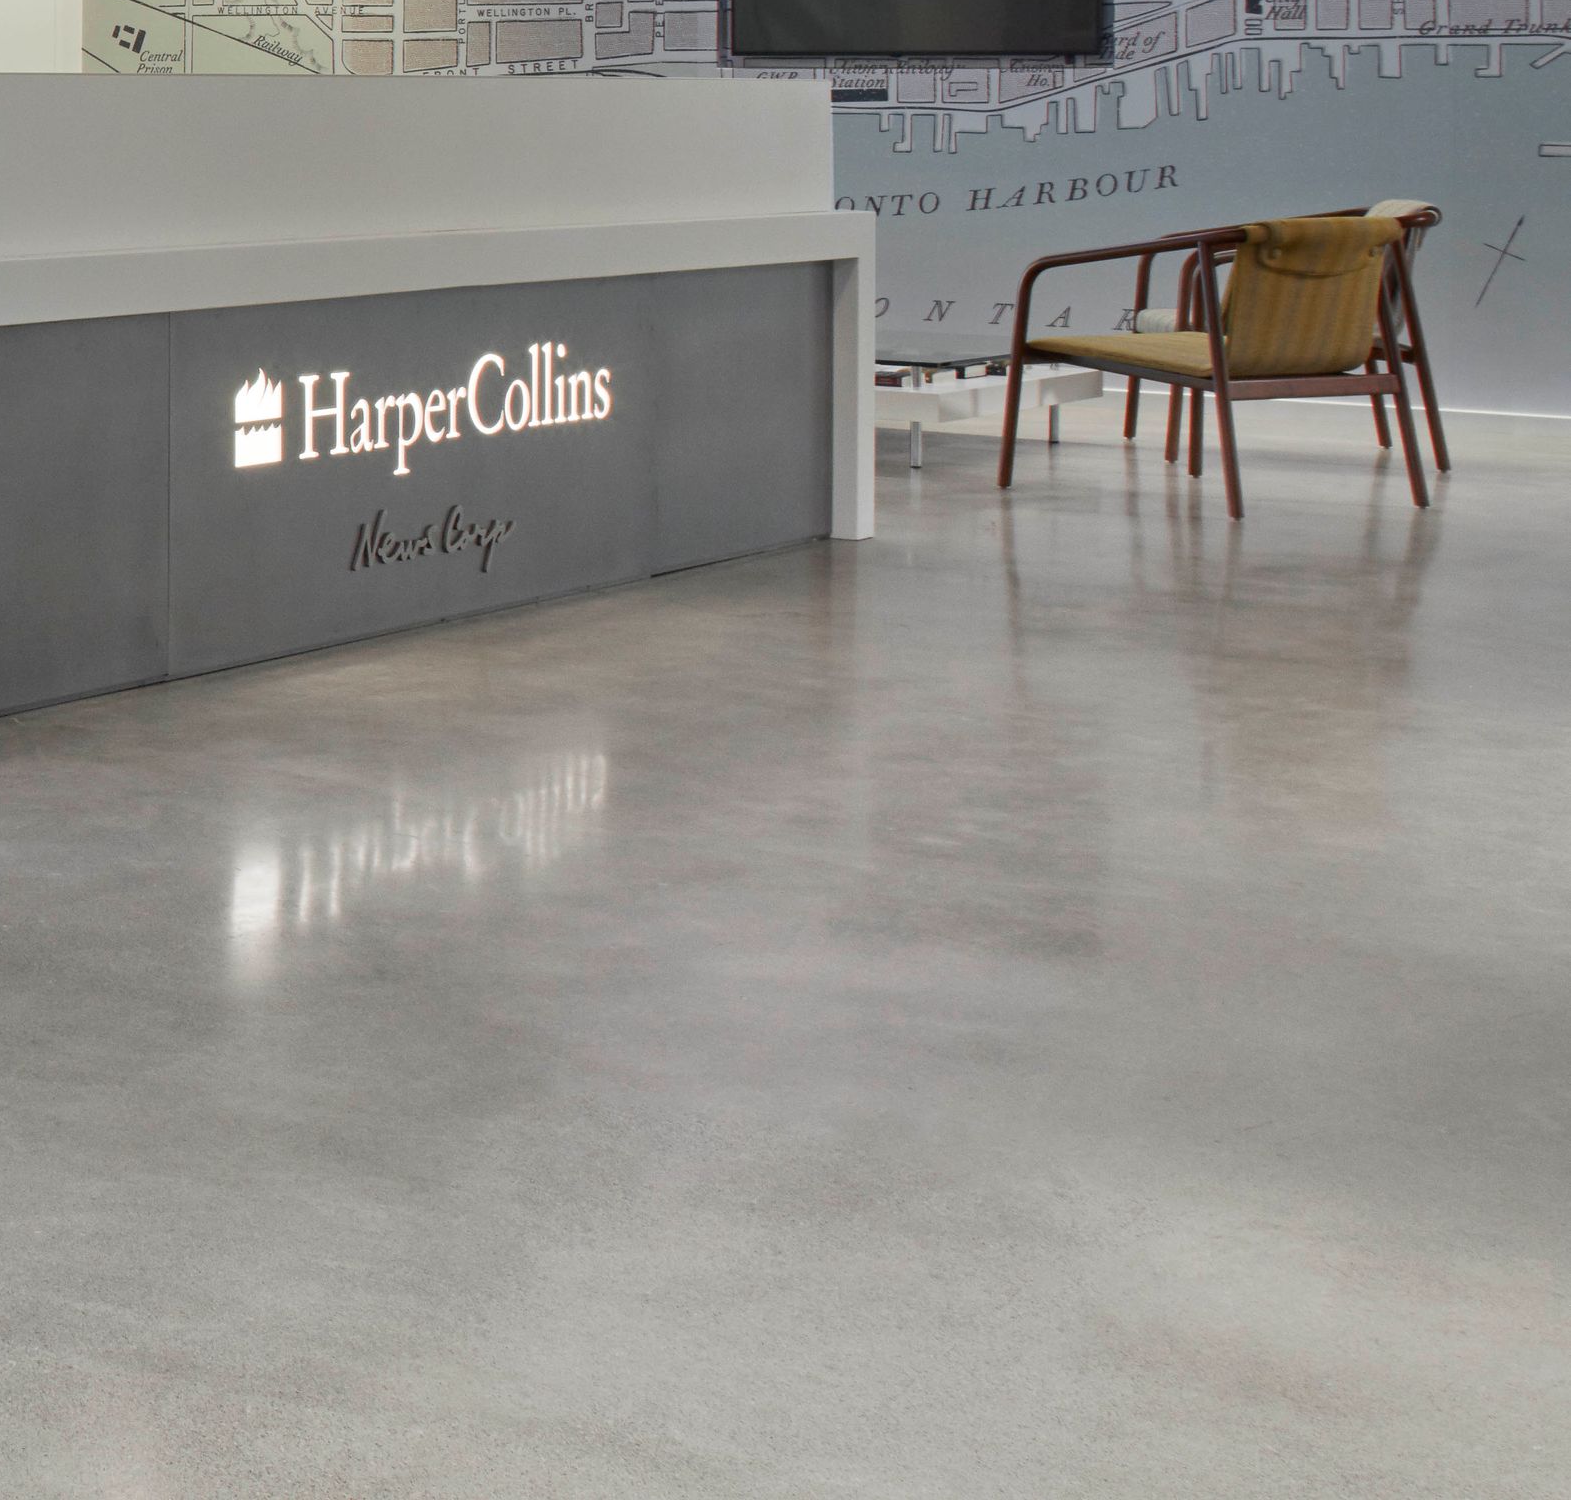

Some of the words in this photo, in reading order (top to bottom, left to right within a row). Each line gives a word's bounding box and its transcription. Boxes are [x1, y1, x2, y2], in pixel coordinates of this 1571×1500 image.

[217, 6, 299, 16] WELLINGTON
[313, 5, 366, 16] AVENUE
[476, 7, 551, 18] WELLINGTON
[557, 6, 577, 17] PL.
[1265, 4, 1306, 21] Hall
[1418, 18, 1491, 36] Grand
[139, 49, 184, 63] Central
[253, 34, 304, 67] Railway
[508, 59, 580, 75] STREET
[831, 76, 886, 89] Station
[1025, 73, 1050, 87] Ho.
[964, 164, 1179, 213] HARBOUR
[298, 341, 612, 476] HarperCollins
[349, 509, 439, 572] News
[442, 504, 517, 573] Corp
